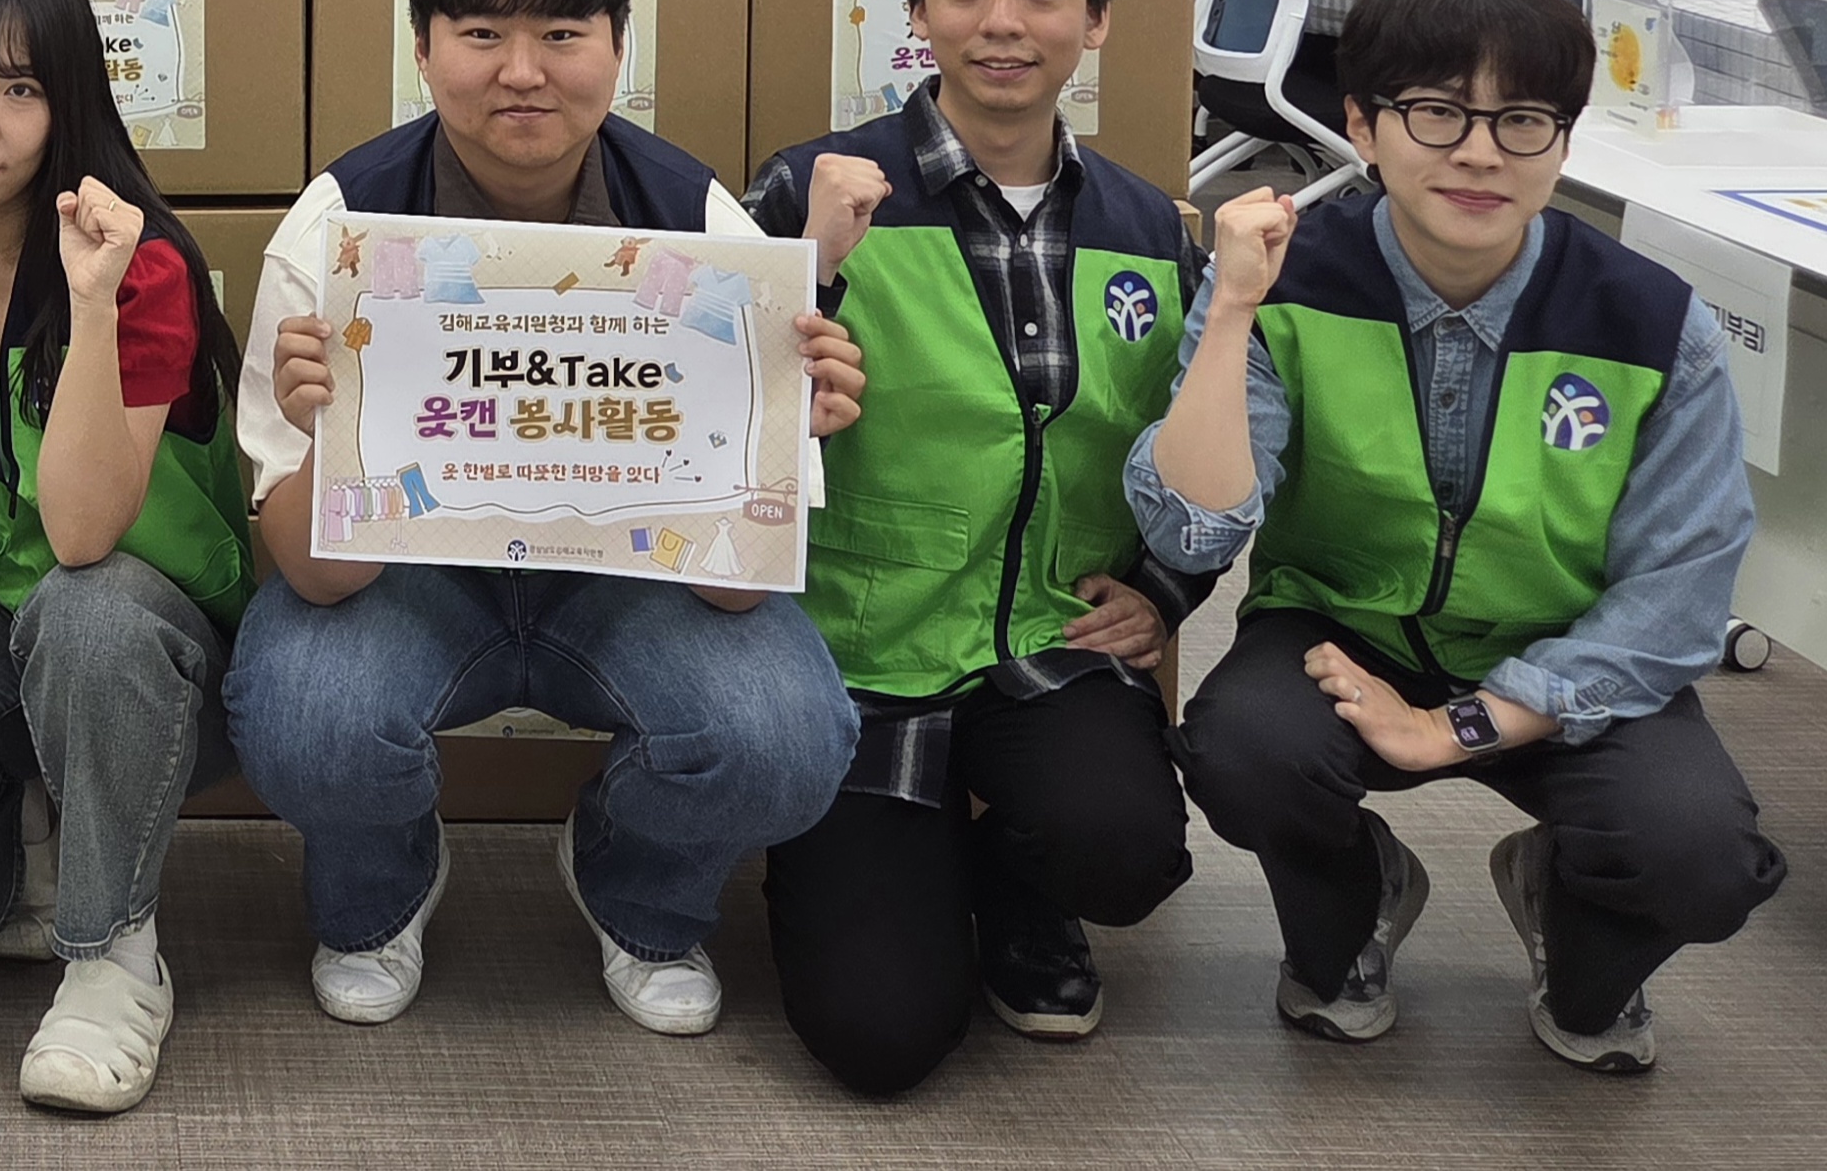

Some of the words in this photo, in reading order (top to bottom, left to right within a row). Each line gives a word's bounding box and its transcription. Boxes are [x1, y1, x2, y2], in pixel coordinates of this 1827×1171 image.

[438, 313, 584, 333] 김해교육지원청과
[589, 314, 626, 334] 함께
[632, 316, 669, 335] 하는
[445, 348, 662, 388] 기부&Take
[416, 395, 497, 439] 옷캔
[509, 396, 681, 442] 봉사활동
[442, 463, 459, 480] 옷
[463, 462, 513, 481] 한벌로
[517, 463, 567, 482] 따뜻한
[571, 464, 622, 483] 희망을
[750, 505, 783, 518] OPEN
